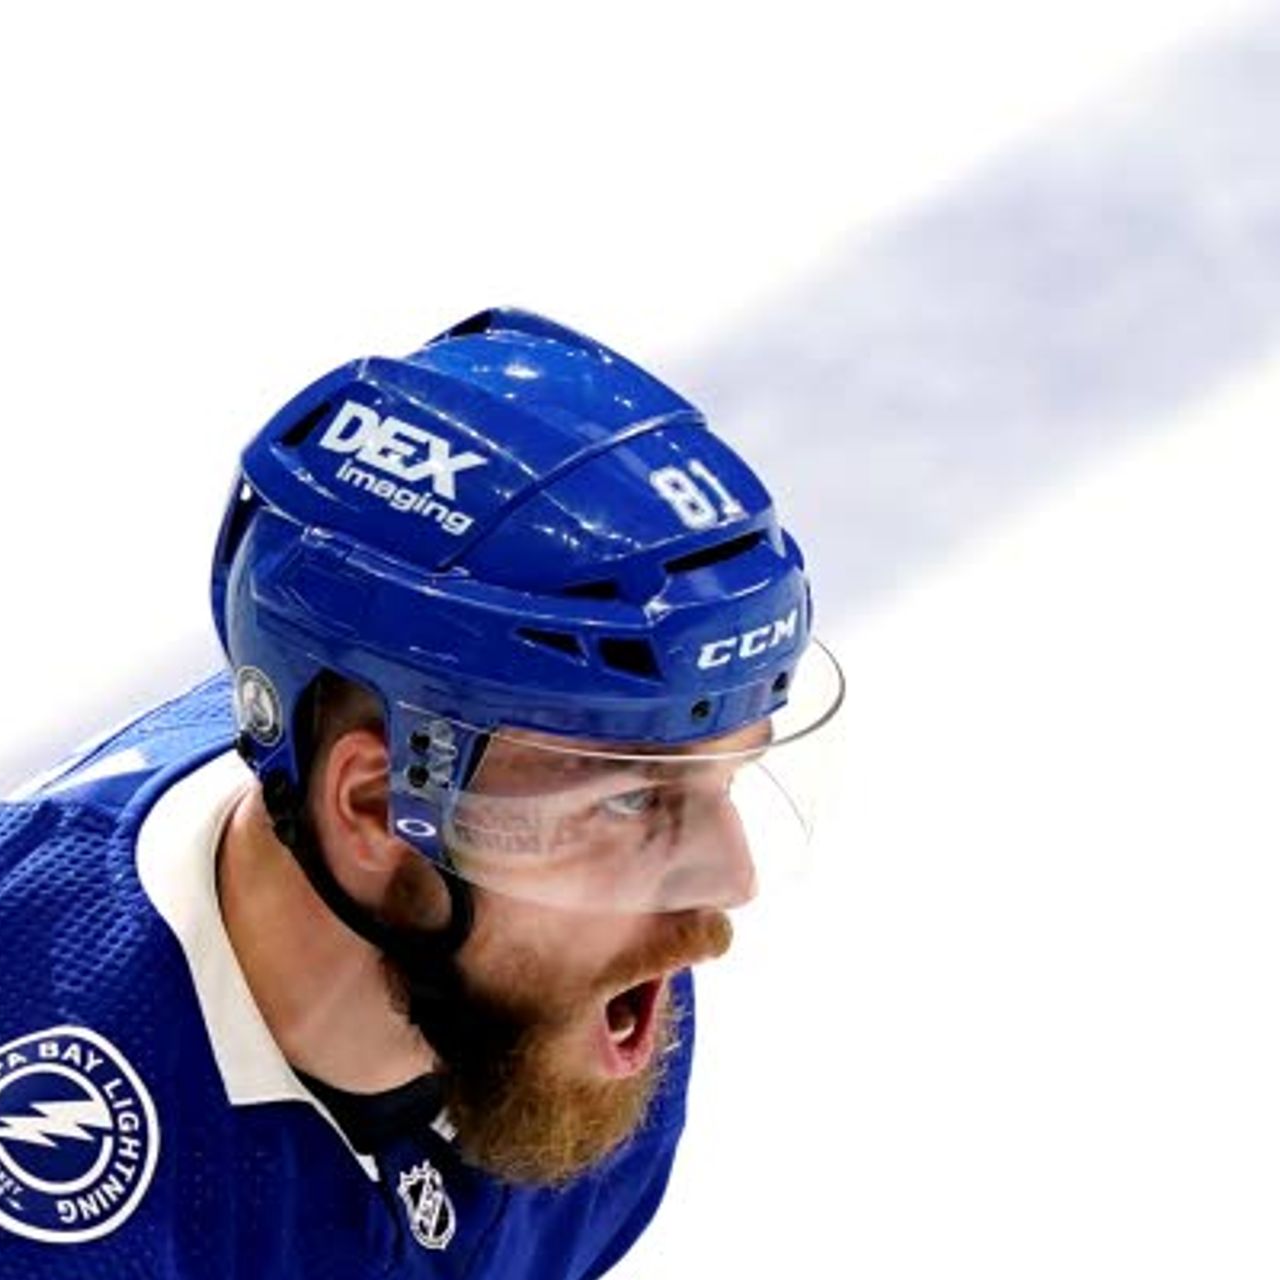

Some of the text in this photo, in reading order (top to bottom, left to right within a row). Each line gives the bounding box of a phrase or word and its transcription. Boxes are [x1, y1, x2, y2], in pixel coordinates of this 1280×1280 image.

[319, 400, 488, 500] DEX
[336, 459, 474, 535] imaging
[649, 458, 748, 531] 81
[697, 610, 798, 669] CCM
[38, 1043, 103, 1073] BAY
[56, 1078, 141, 1223] LIGHTNING
